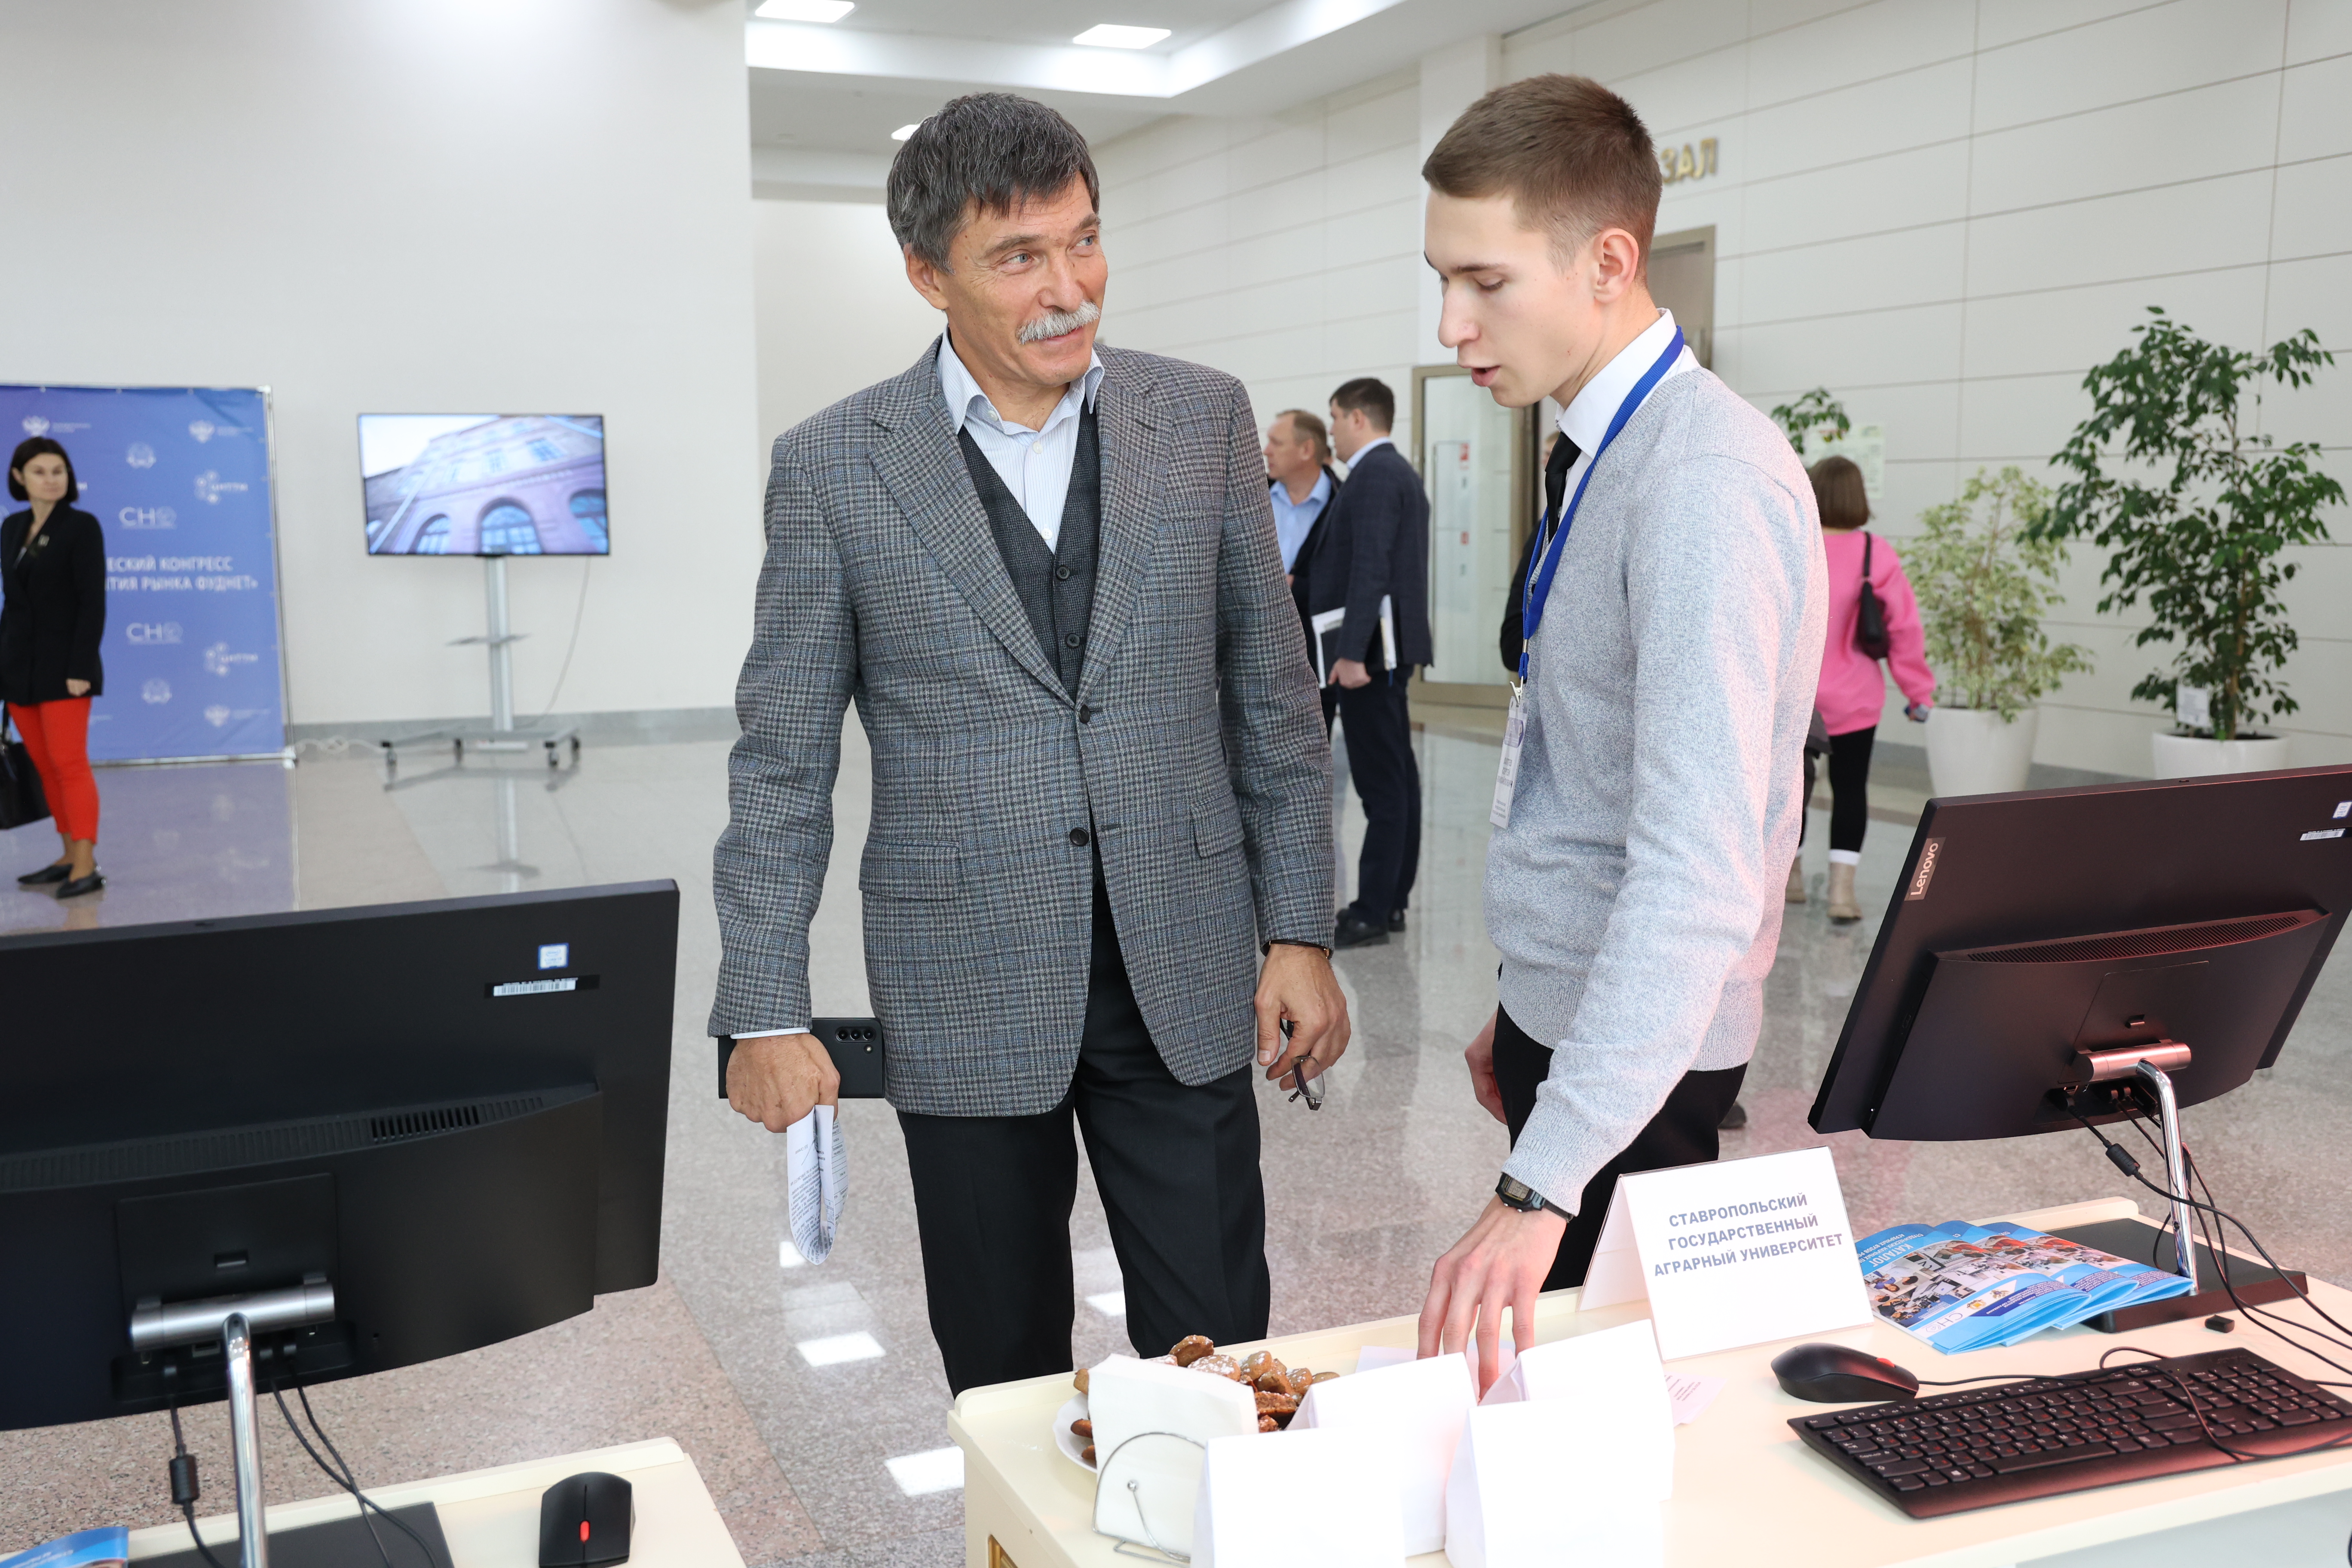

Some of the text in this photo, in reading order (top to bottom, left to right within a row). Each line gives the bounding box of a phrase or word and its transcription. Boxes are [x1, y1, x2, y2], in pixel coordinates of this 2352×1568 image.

[1661, 138, 1717, 184] ЗАЛ
[1911, 843, 1939, 895] Lenovo
[1669, 1192, 1808, 1227] СТАВРОПОЛЬСКИЙ
[1668, 1213, 1819, 1250] ГОСУДАРСТВЕННЫЙ
[1654, 1233, 1843, 1277] АГРАРНЫЙ УНИВЕРСИТЕТ
[1868, 1243, 1914, 1267] КАТАЛОГ
